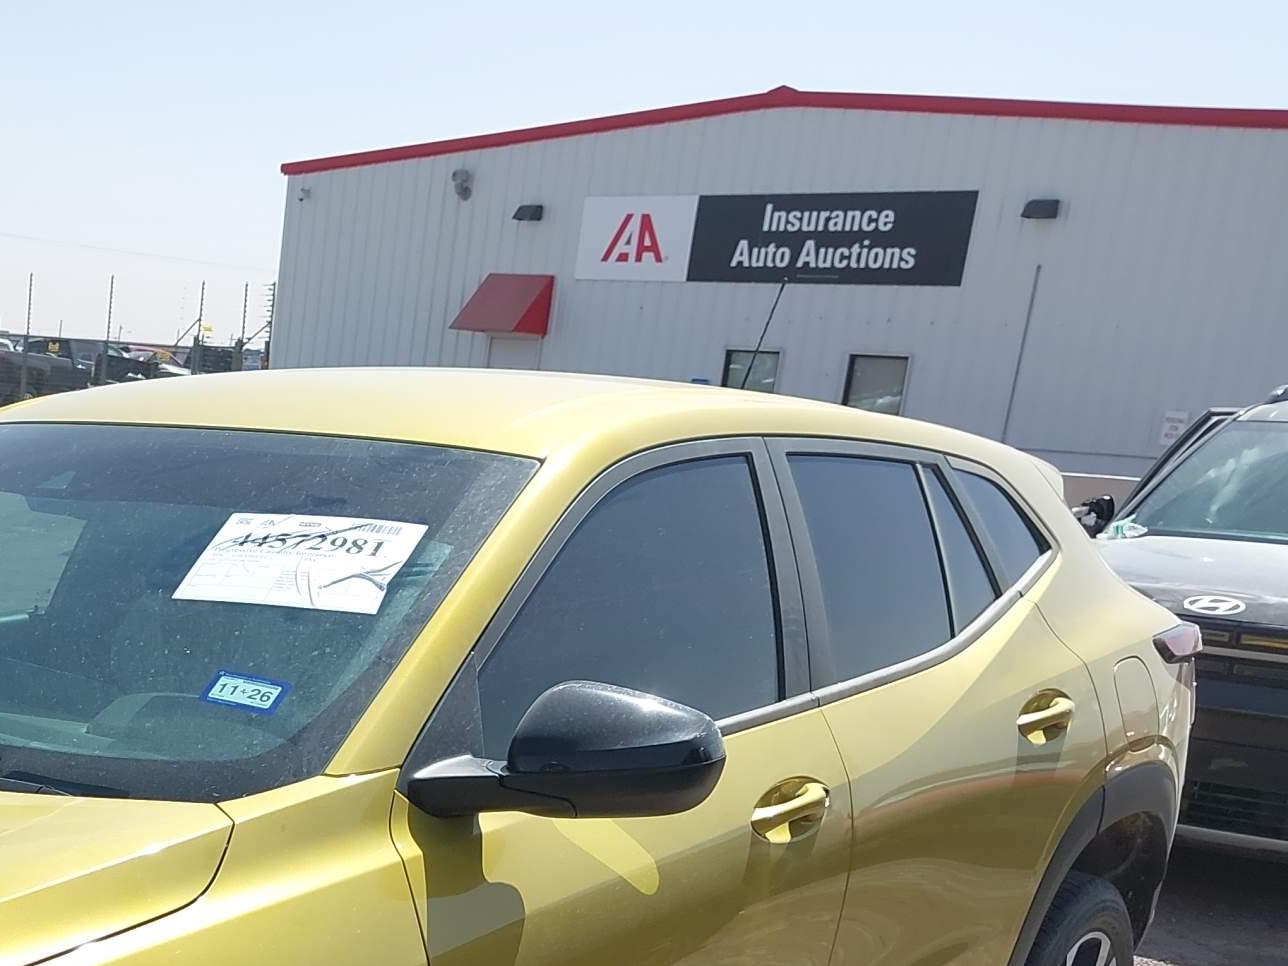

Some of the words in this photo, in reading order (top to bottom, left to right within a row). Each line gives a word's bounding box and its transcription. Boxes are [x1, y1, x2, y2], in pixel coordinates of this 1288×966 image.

[762, 203, 895, 232] Insurance
[730, 239, 791, 268] Auto
[795, 239, 917, 270] Auctions
[232, 532, 386, 558] 44572981
